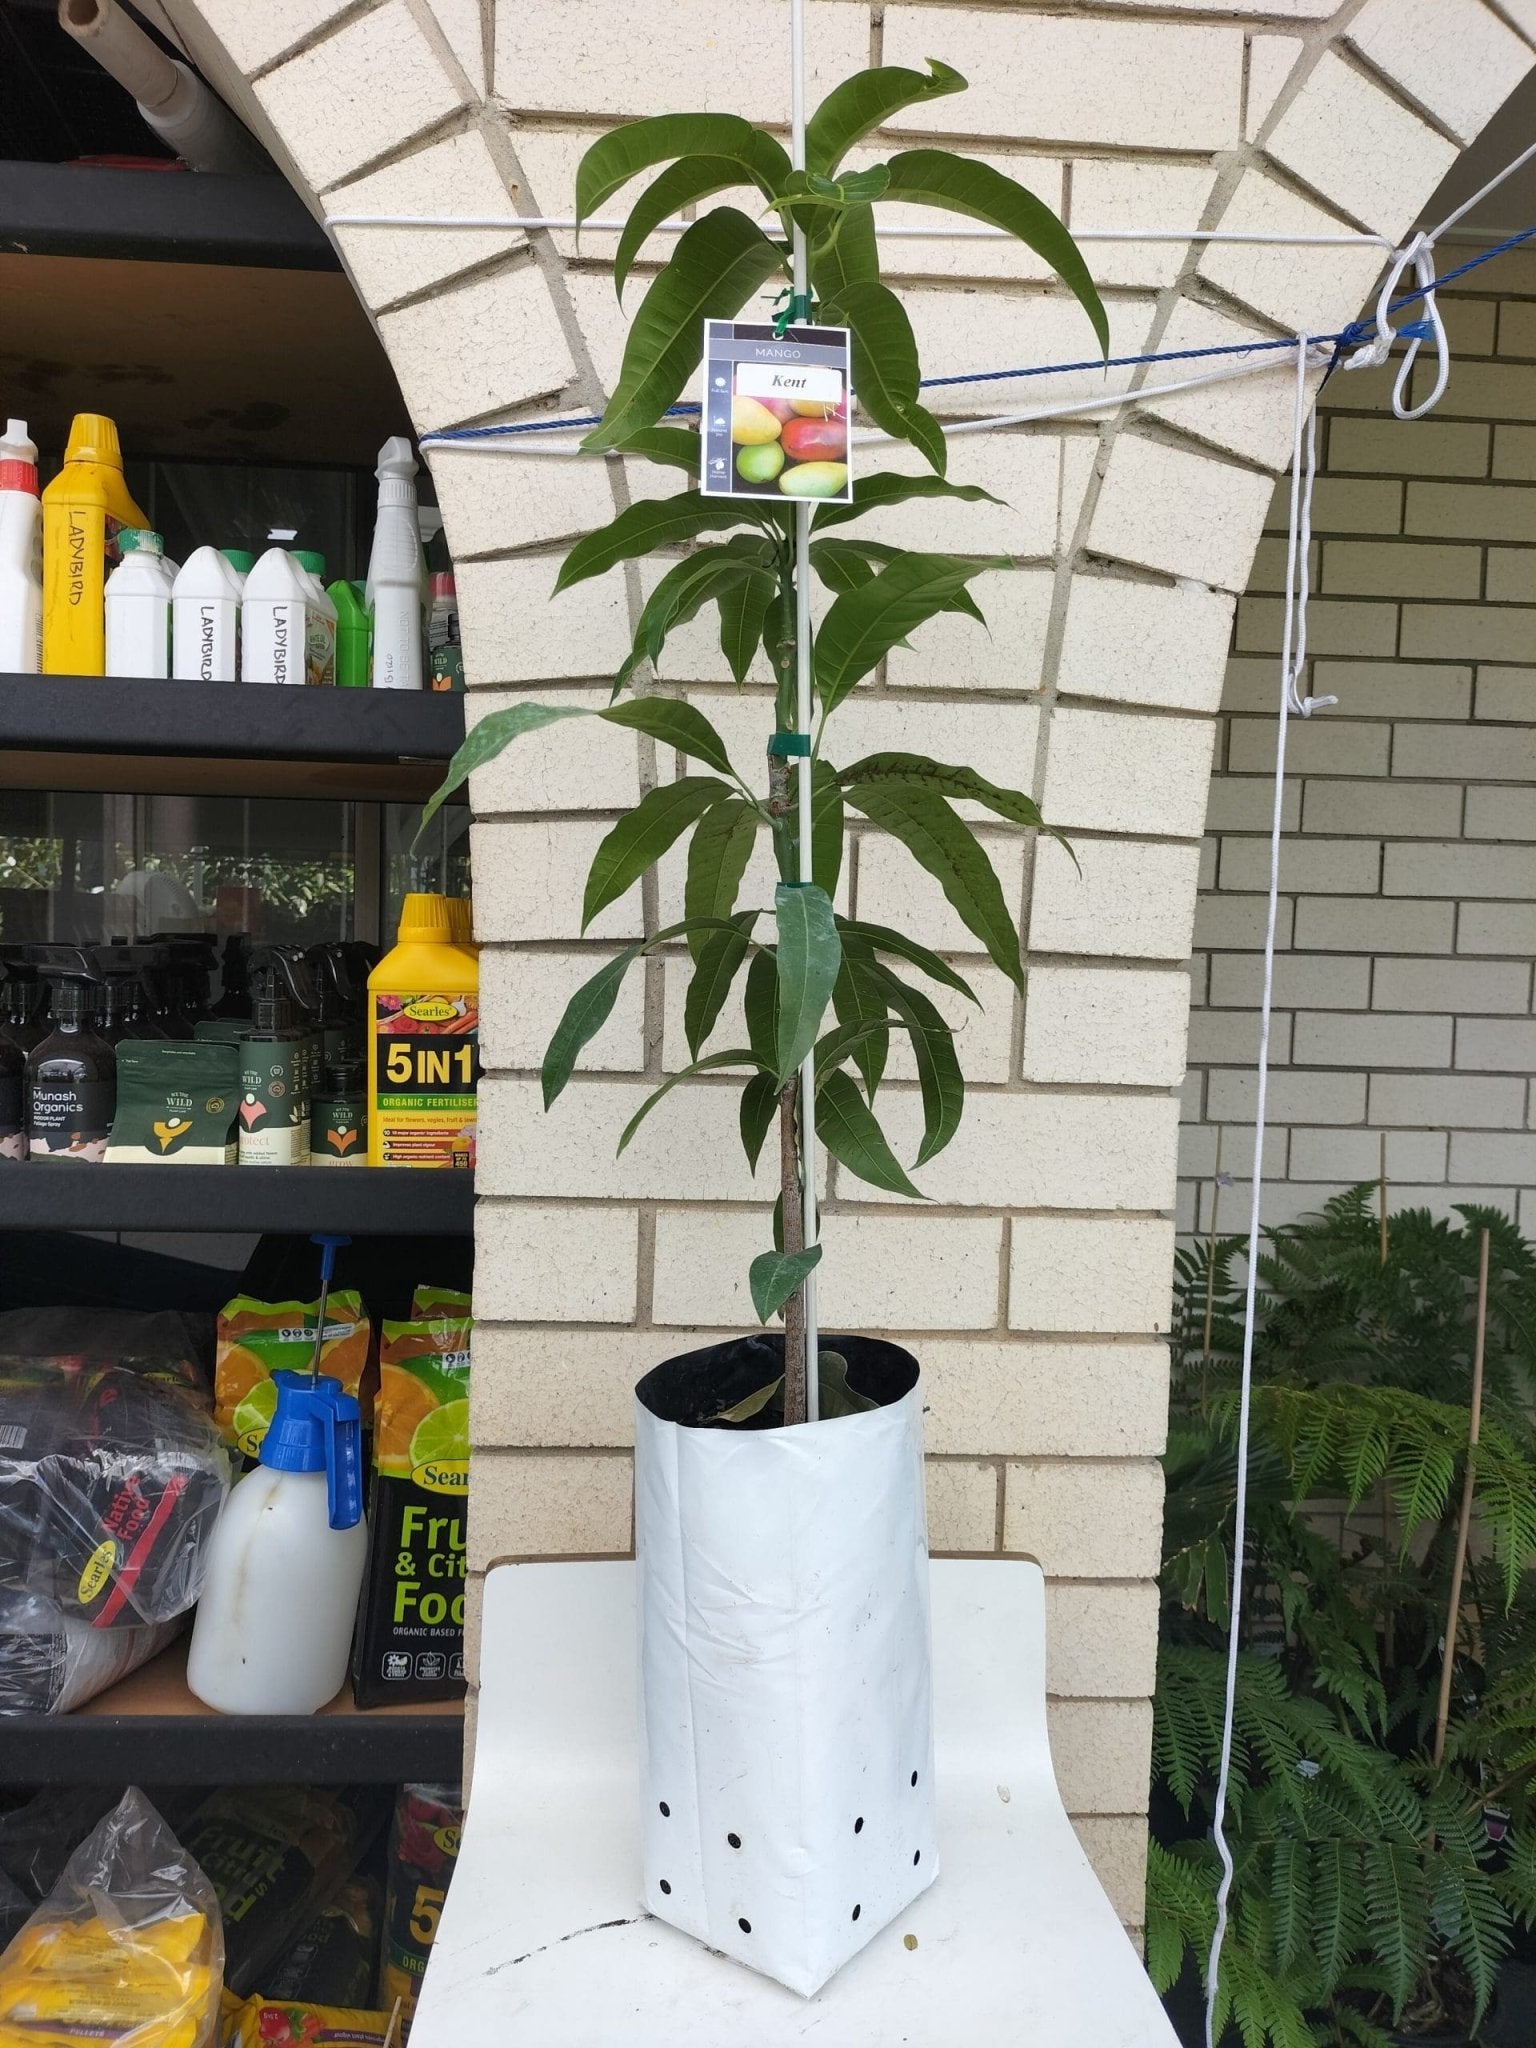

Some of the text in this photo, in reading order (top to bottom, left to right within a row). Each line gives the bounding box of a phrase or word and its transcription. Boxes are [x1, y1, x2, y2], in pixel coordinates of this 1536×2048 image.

[755, 348, 801, 359] MANGO
[772, 374, 807, 388] Kent
[200, 606, 215, 681] LADYBIRD
[272, 606, 288, 685] LADYBIRD
[410, 1006, 450, 1017] Searles
[386, 1043, 472, 1084] 5 IN 1
[242, 1075, 262, 1085] WILD
[33, 1090, 77, 1101] Munash
[383, 1097, 423, 1107] ORGANIC
[33, 1101, 84, 1114] Organics
[166, 1097, 193, 1108] WILD
[332, 1111, 353, 1119] WILD
[102, 1474, 141, 1534] Native
[117, 1498, 150, 1541] Food
[394, 1551, 417, 1577] &
[392, 1626, 428, 1637] ORGANIC
[430, 1627, 455, 1637] BASED
[409, 1884, 446, 1945] 5
[402, 1955, 425, 1973] ORG
[69, 2026, 105, 2038] PELLETS
